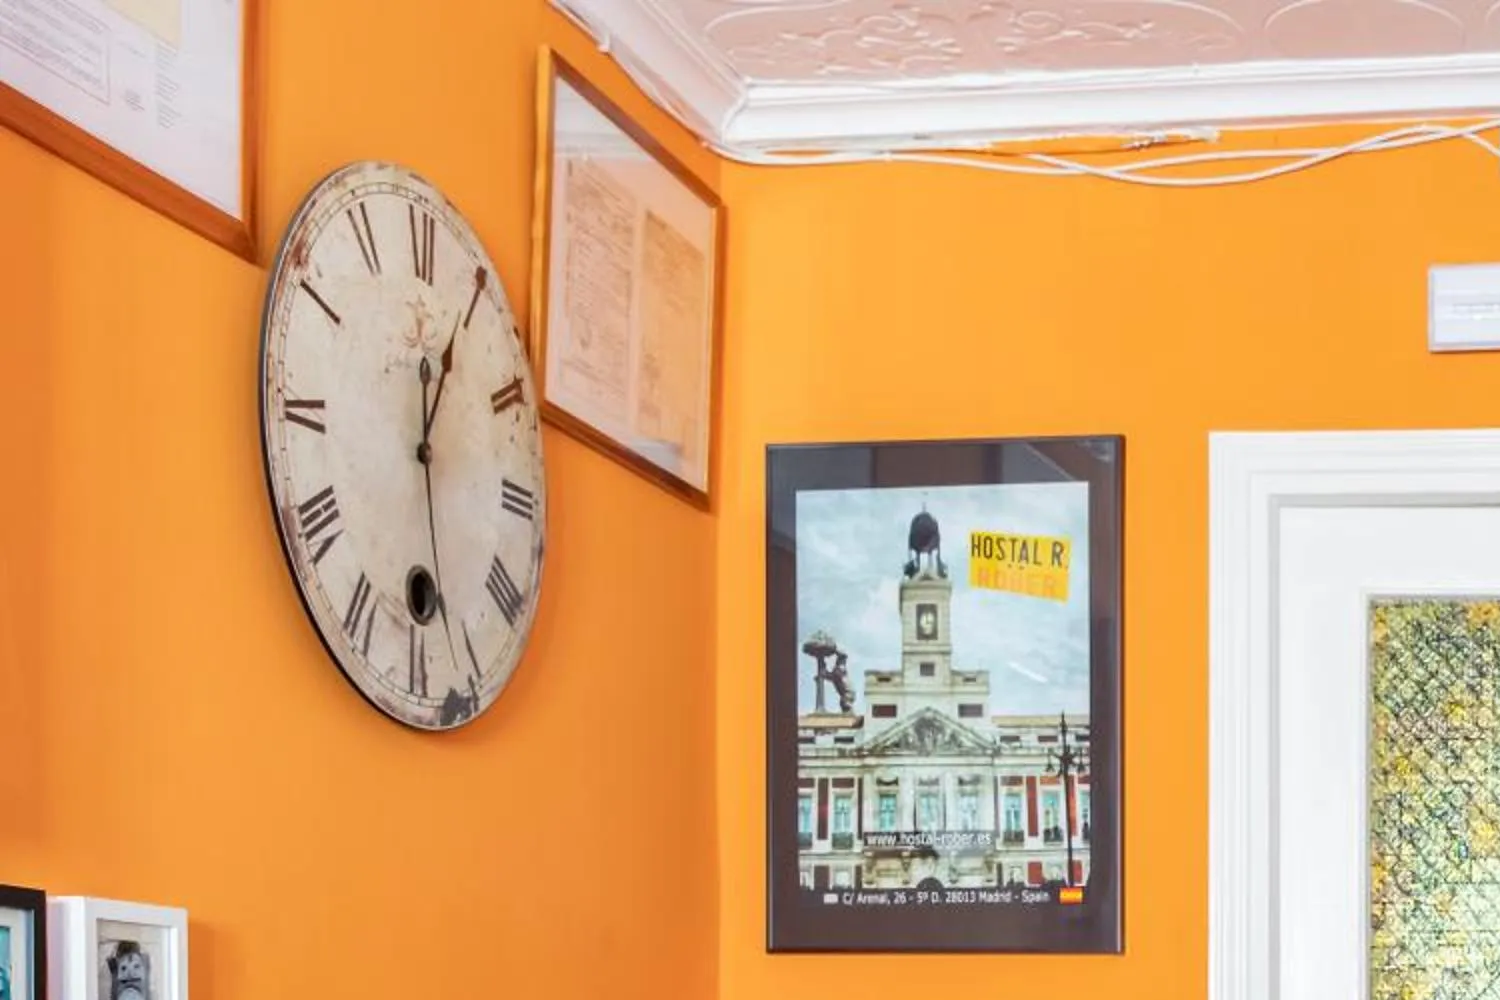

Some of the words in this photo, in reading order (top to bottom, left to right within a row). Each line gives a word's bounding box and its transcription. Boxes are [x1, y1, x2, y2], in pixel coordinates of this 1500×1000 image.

[970, 533, 1042, 566] HOSTAL
[979, 890, 1012, 904] Madrid
[1021, 889, 1048, 904] Spain
